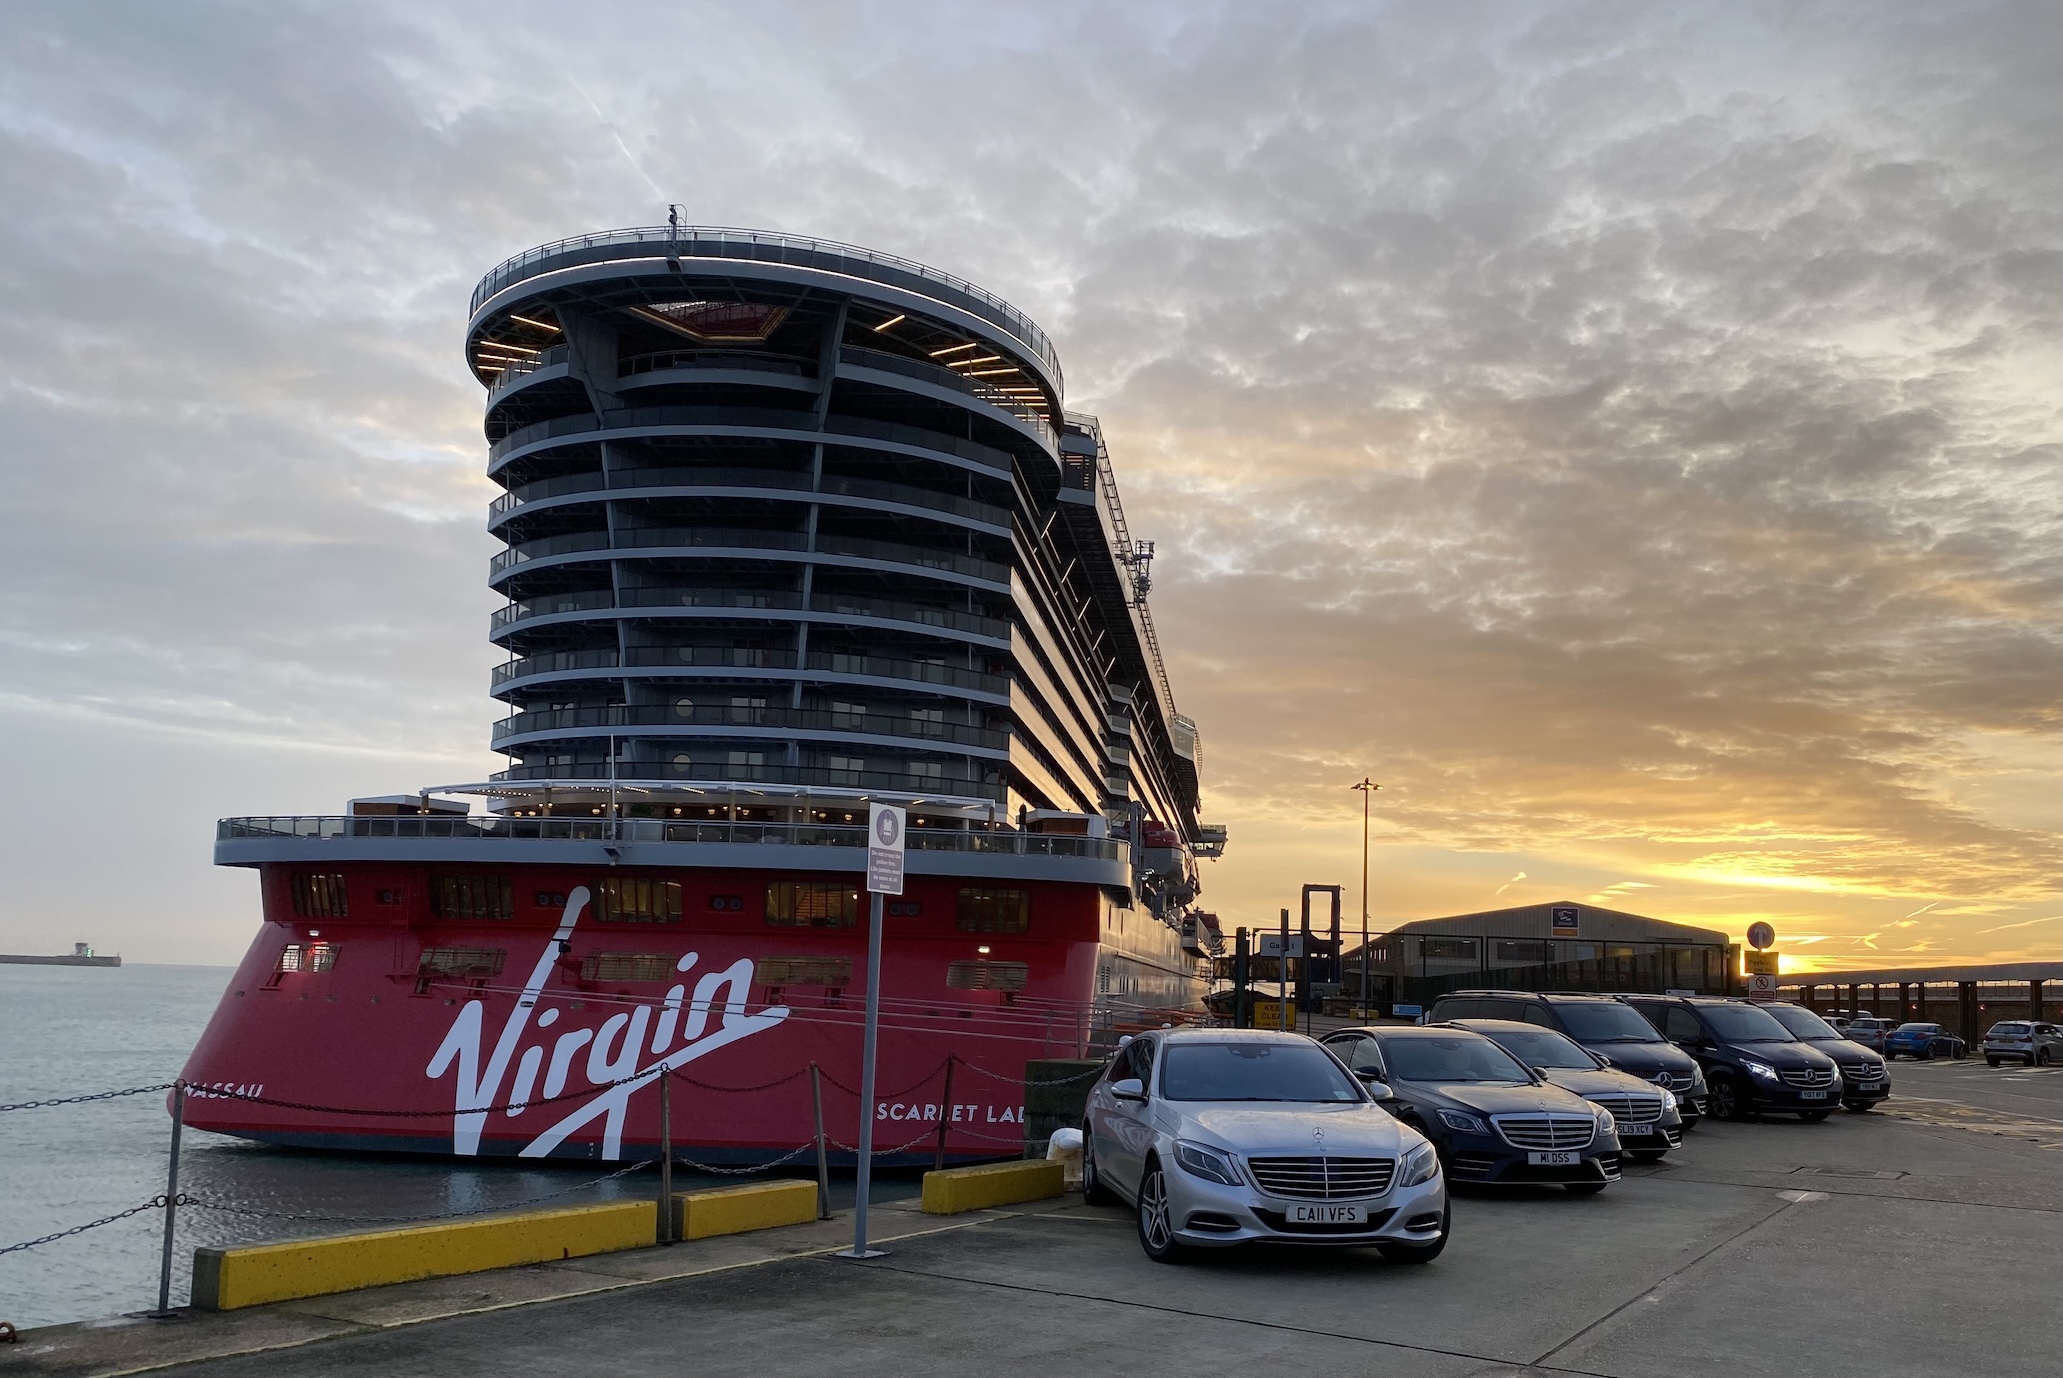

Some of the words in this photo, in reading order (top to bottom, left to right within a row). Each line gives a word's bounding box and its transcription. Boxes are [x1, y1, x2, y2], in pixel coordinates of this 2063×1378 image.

[426, 885, 790, 1160] Virgin
[183, 1081, 263, 1099] NASSAU
[986, 1105, 1025, 1123] LAD
[1635, 1125, 1649, 1134] XCY
[1552, 1153, 1570, 1163] DSS
[1329, 1207, 1356, 1221] VFS
